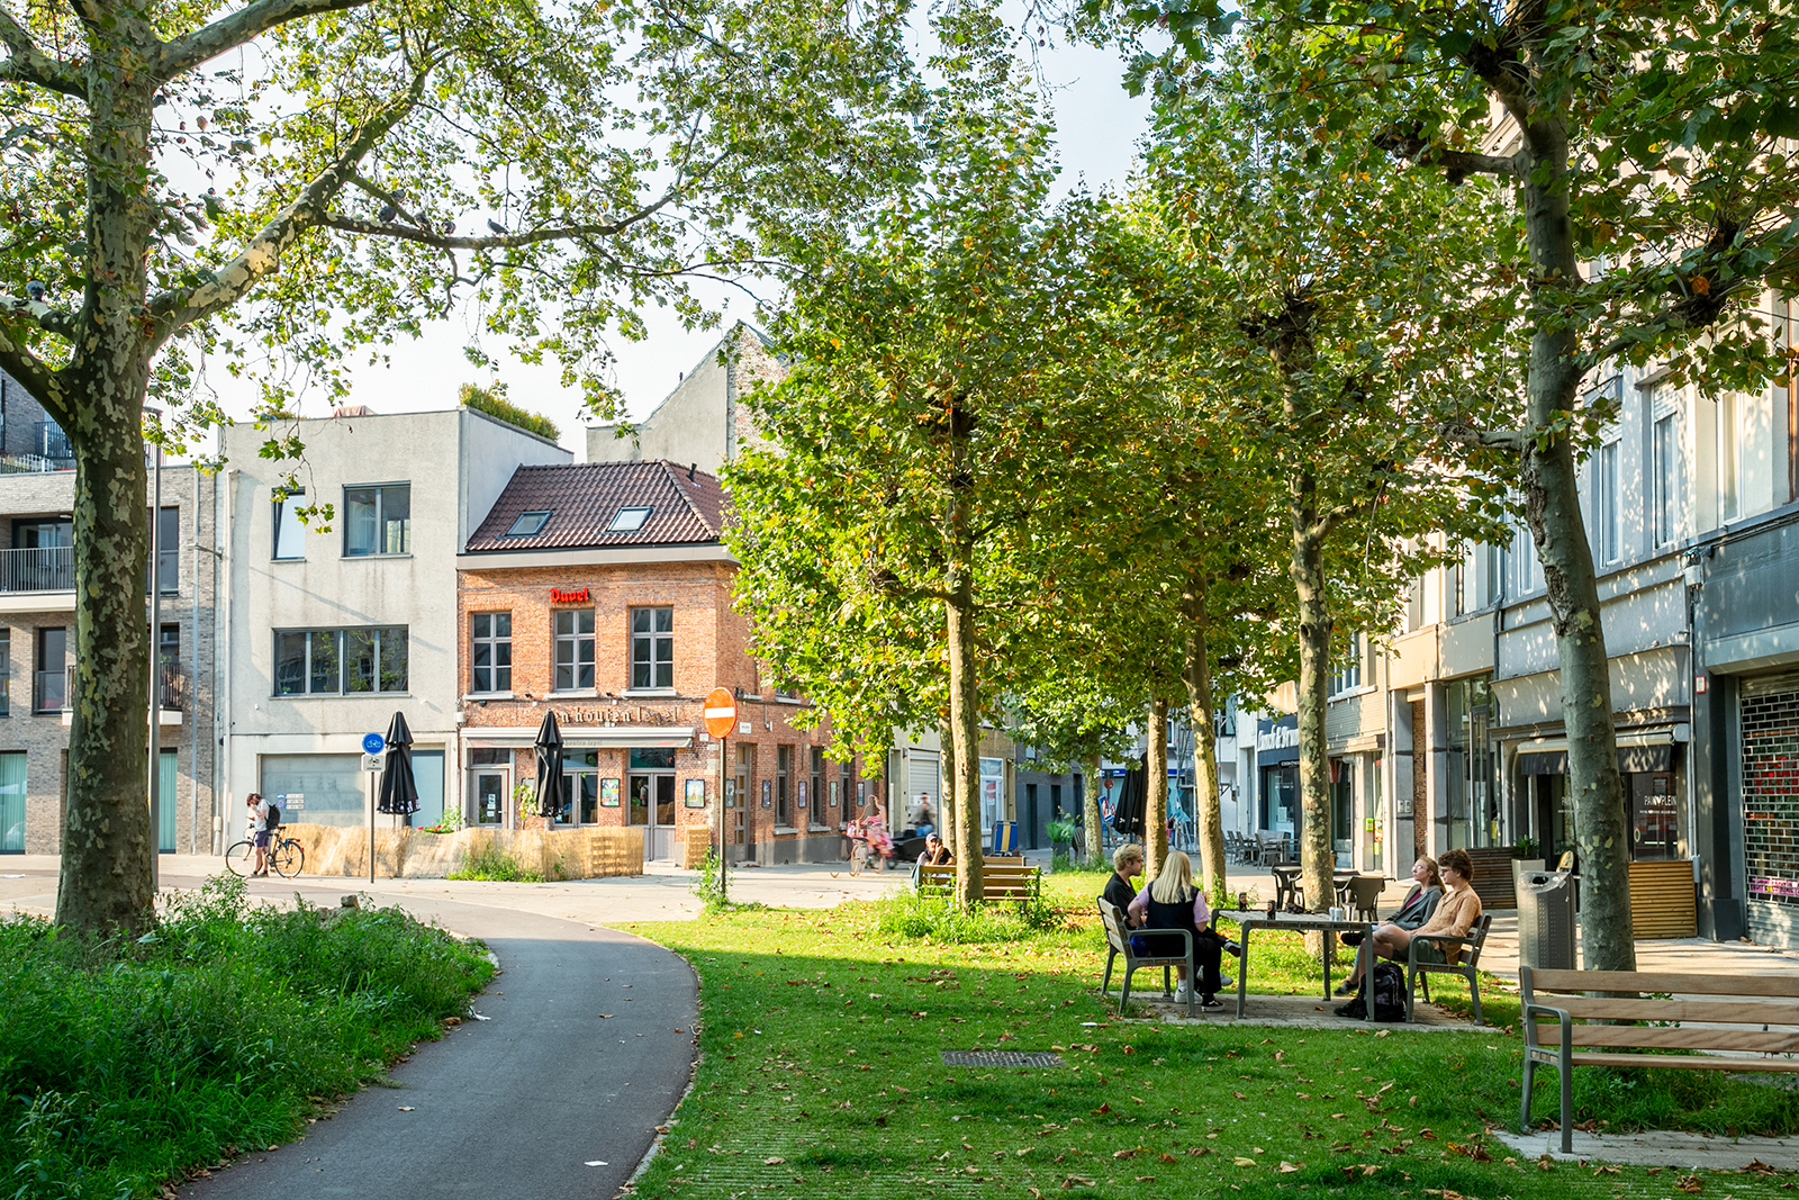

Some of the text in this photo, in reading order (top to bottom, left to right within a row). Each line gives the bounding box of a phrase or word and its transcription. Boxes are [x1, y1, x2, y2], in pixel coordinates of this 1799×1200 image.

[550, 586, 589, 604] Duvel
[575, 706, 632, 722] houten
[638, 705, 679, 726] lepel
